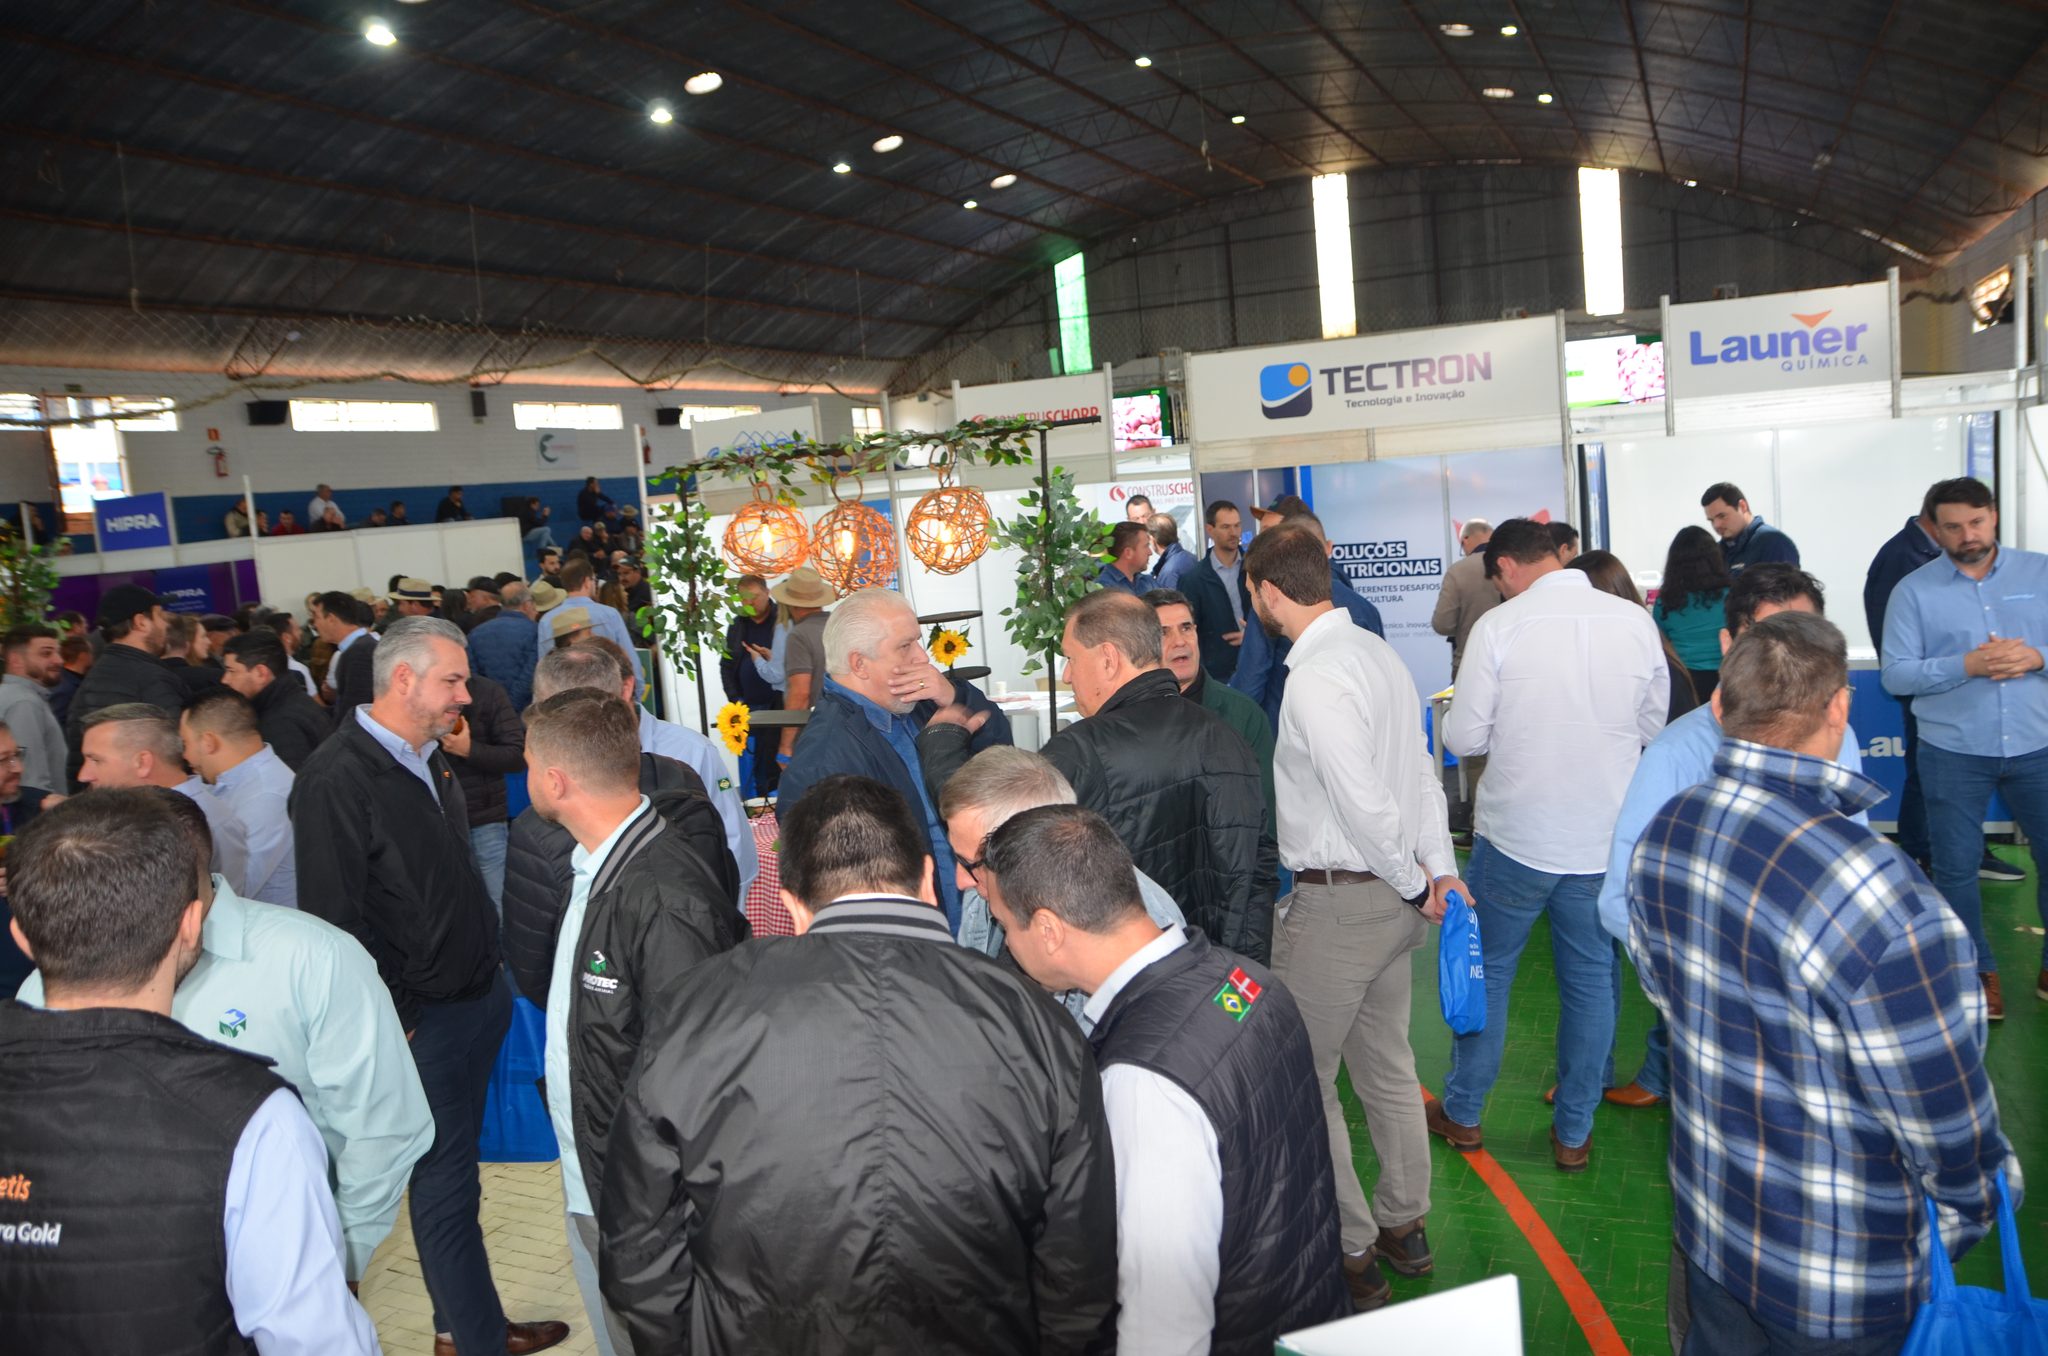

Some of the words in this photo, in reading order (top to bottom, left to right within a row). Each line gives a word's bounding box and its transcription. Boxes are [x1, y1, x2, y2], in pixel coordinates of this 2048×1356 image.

[1689, 322, 1869, 366] Launer
[1319, 351, 1492, 396] TECTRON
[1780, 353, 1869, 373] QUÍMICA
[1345, 395, 1403, 409] Tecnologia
[1405, 394, 1413, 403] e
[1415, 390, 1466, 403] Inovação
[105, 512, 163, 534] HIPRA
[1328, 542, 1406, 560] OLUÇÕES
[1400, 582, 1441, 592] DESAFIOS
[17, 1220, 62, 1246] Gold
